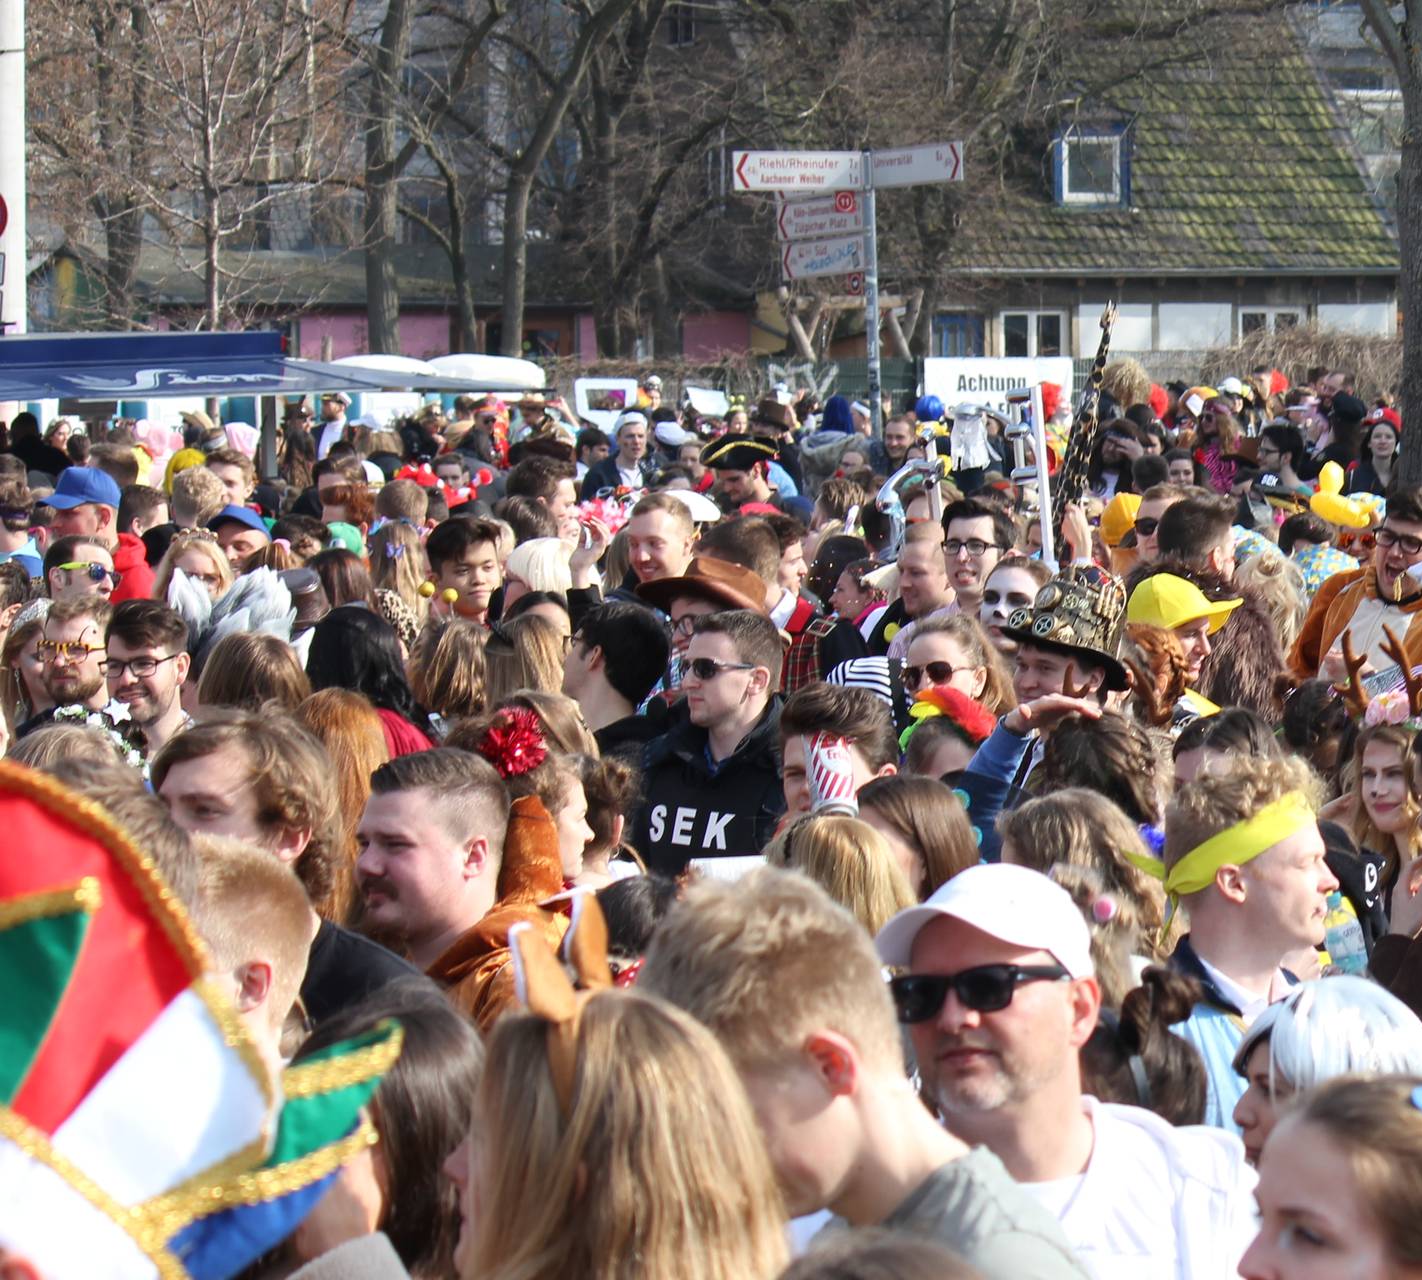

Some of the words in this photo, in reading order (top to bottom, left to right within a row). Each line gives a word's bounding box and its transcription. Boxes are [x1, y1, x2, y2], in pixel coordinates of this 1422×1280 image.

[759, 158, 839, 169] Riehl/Rheinufer
[760, 174, 796, 185] Aachener
[799, 174, 825, 185] Weiher
[649, 804, 736, 850] SEK
